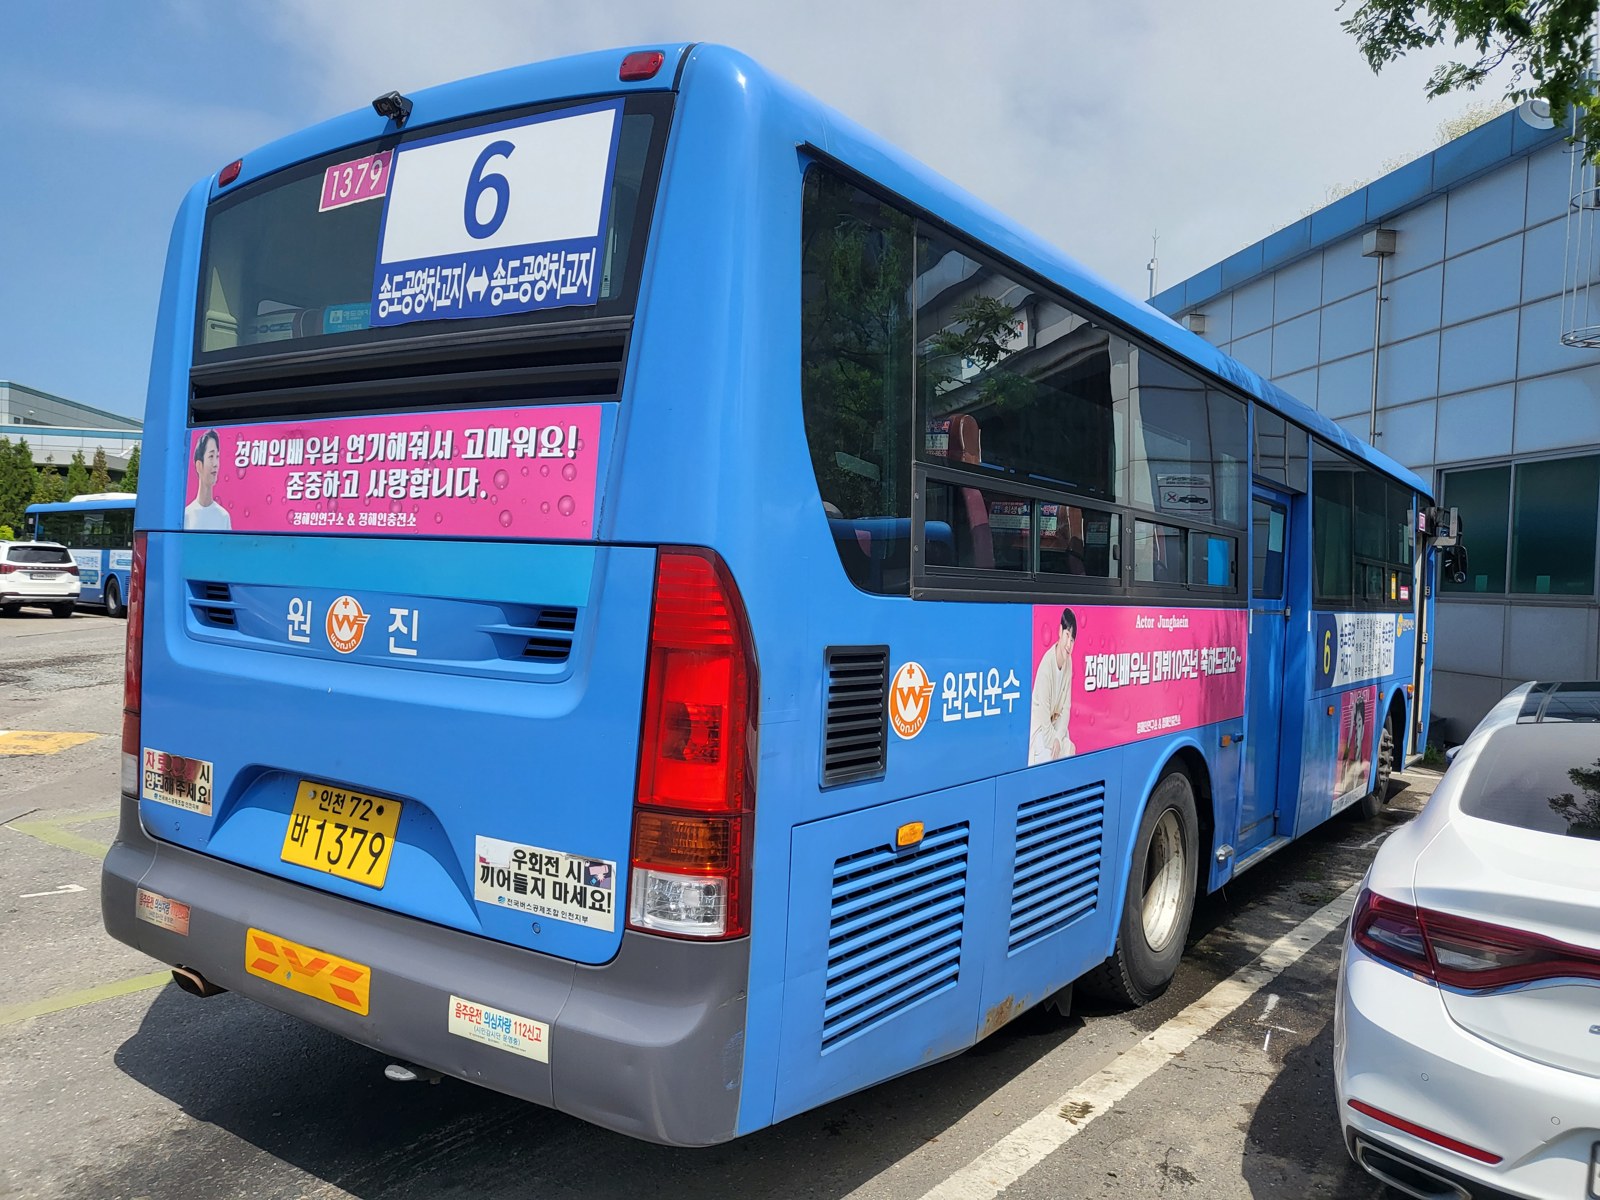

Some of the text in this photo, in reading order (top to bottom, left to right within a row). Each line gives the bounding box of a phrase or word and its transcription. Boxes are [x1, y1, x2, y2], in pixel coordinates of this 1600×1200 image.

[331, 159, 382, 201] 1379
[464, 140, 516, 240] 6
[378, 247, 596, 318] 송도공영차고지 송도공영차고지
[235, 425, 577, 467] 정해인배우님 연기해줘서 고마워요!
[287, 467, 487, 499] 존중하고 사랑합니다.
[293, 512, 416, 527] 정해인연구소 & 정해인충전소
[287, 597, 419, 656] 원 진
[1136, 614, 1189, 632] Actor Junghaein
[1084, 652, 1150, 692] 정해인배우님
[1152, 648, 1199, 681] 데뷔10주년
[1323, 630, 1331, 675] 6
[941, 667, 1020, 722] 원진운수
[199, 764, 210, 783] 시
[319, 790, 373, 822] 인천 72
[512, 849, 582, 884] 우회전 시
[480, 864, 612, 914] 끼어들지 마세요!
[507, 898, 589, 924] 전국버스공제조합 인천지부
[455, 1002, 542, 1042] 음주운전 의심차량 112신고
